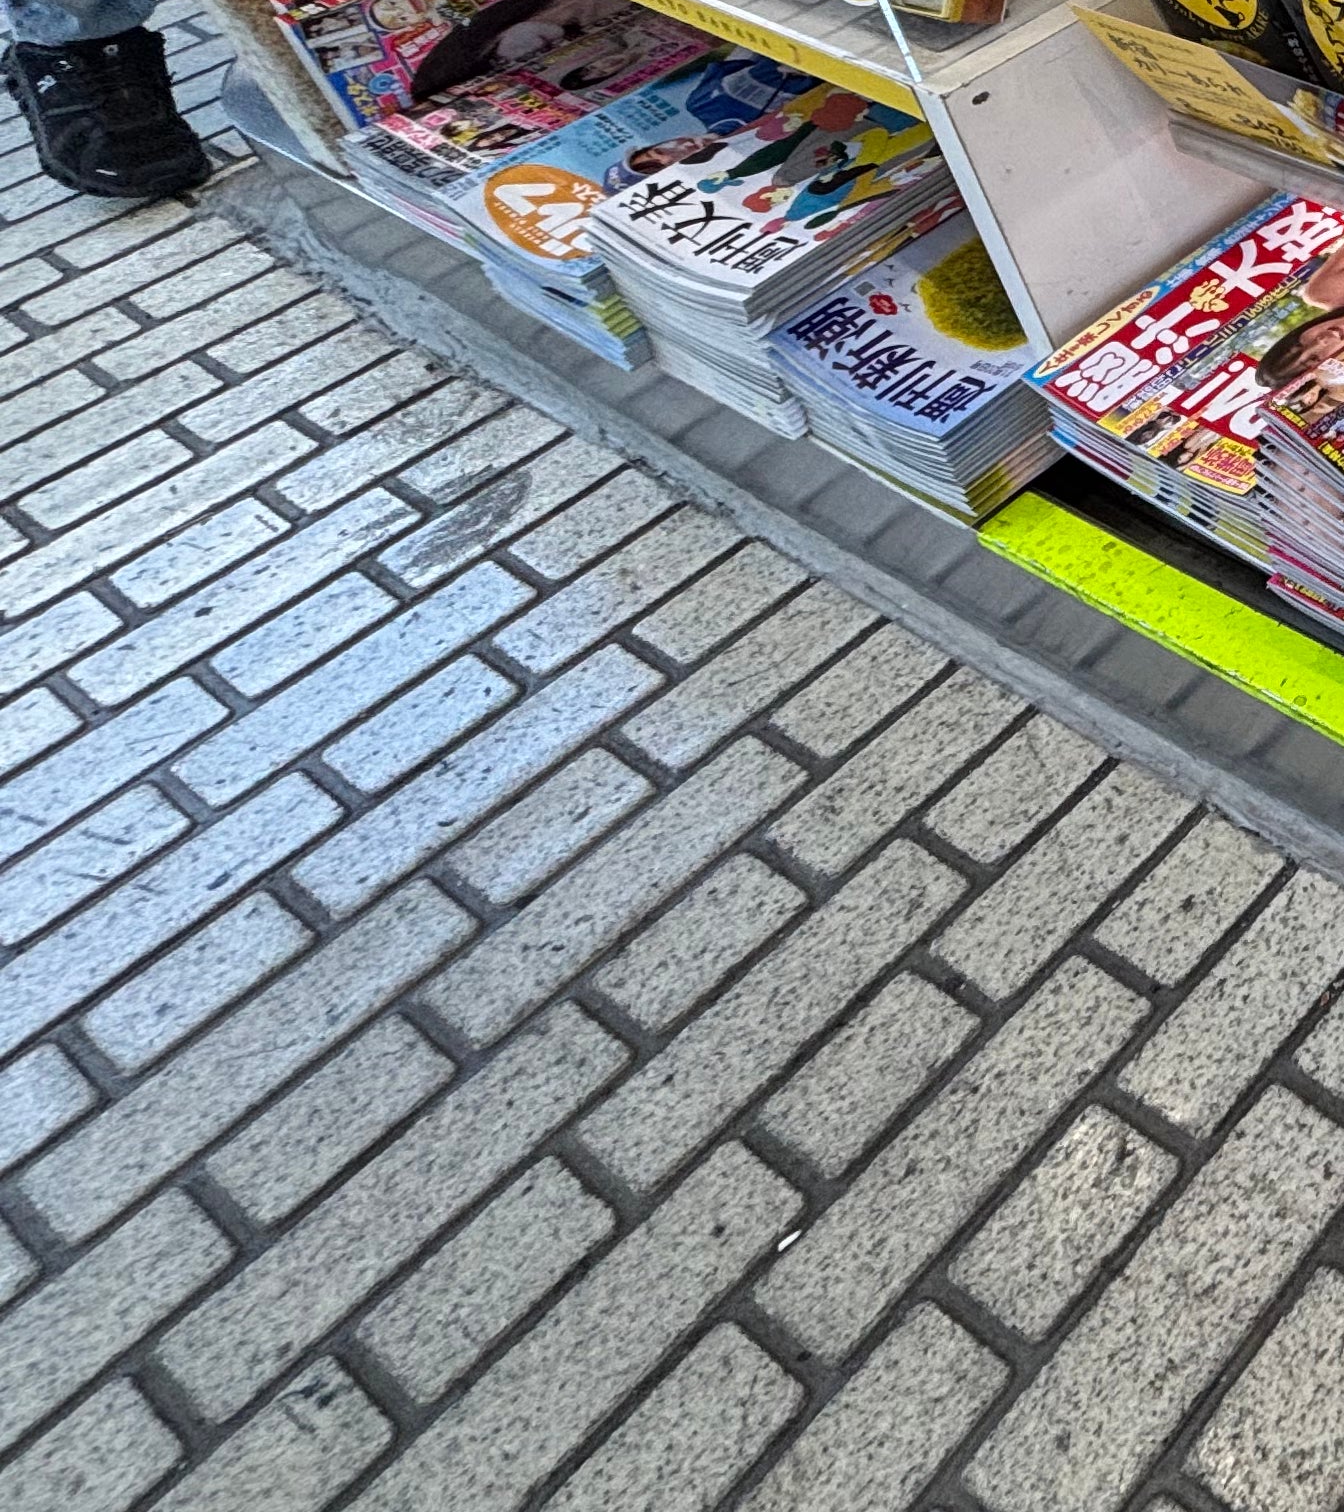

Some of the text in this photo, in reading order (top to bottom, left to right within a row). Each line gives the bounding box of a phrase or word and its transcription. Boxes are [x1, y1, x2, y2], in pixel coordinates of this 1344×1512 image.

[617, 177, 809, 275] 週刊文春
[788, 296, 998, 425] 週刊新潮
